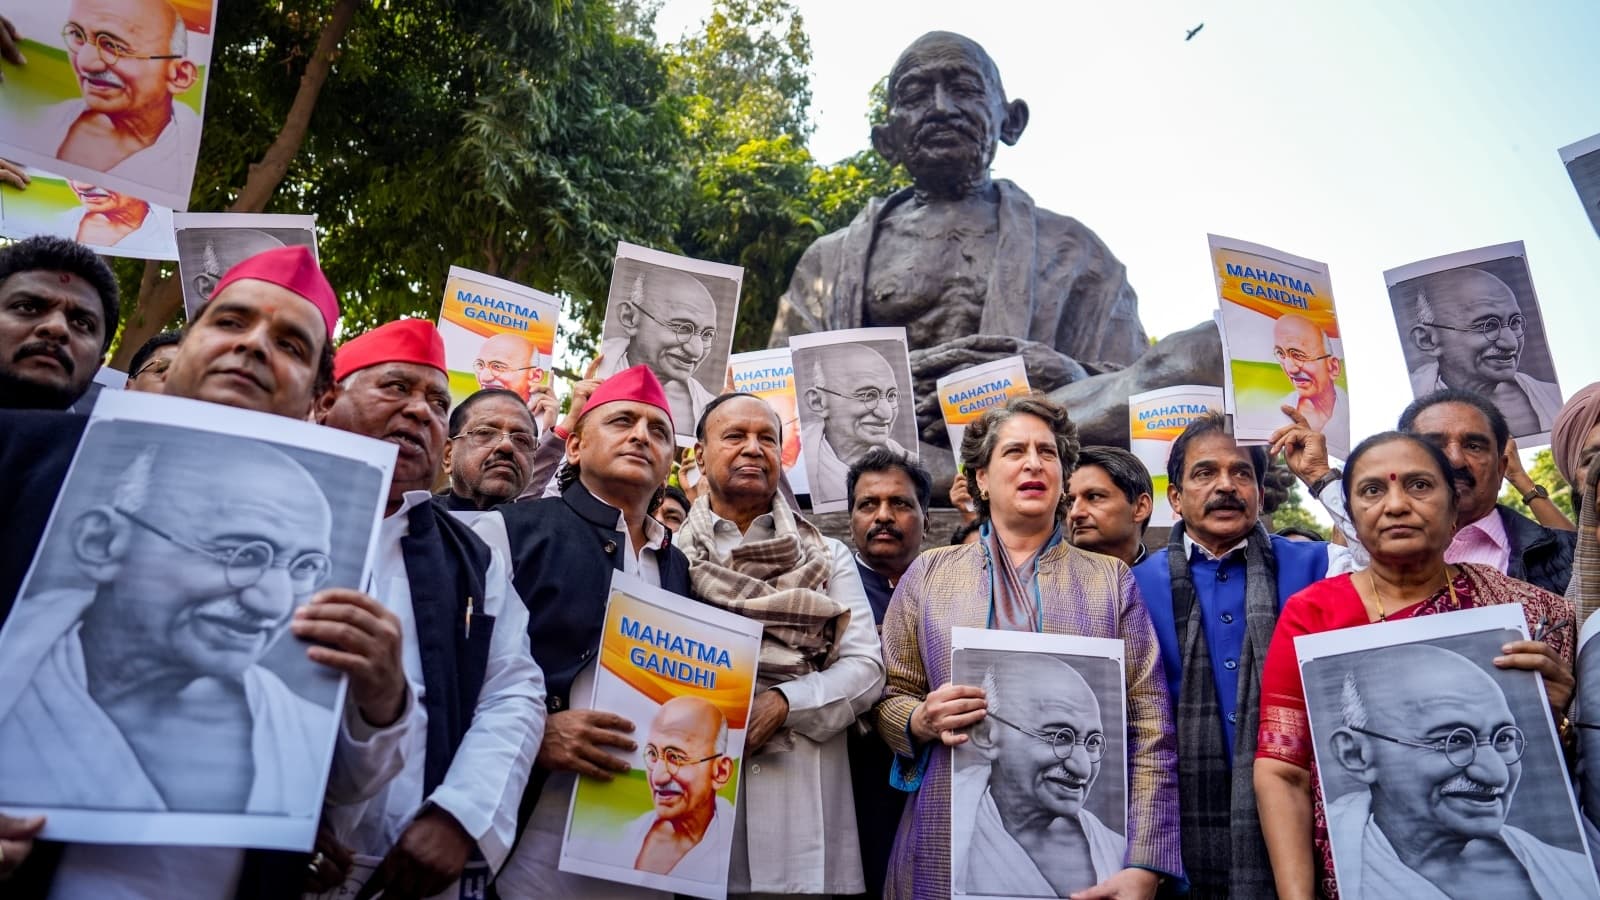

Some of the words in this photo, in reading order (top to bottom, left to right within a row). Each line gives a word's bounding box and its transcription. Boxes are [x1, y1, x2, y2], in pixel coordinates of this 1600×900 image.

[1226, 263, 1315, 296] MAHATMA
[457, 290, 540, 321] MAHATMA
[1241, 282, 1309, 309] GANDHI
[464, 307, 528, 331] GANDHI
[734, 366, 793, 382] AHATMA
[736, 379, 786, 393] ANDHI
[948, 379, 1012, 405] MAHATMA
[959, 393, 1008, 414] GANDHI
[1139, 404, 1208, 420] MAHATMA
[620, 616, 732, 668] MAHATMA
[630, 647, 716, 688] GANDHI
